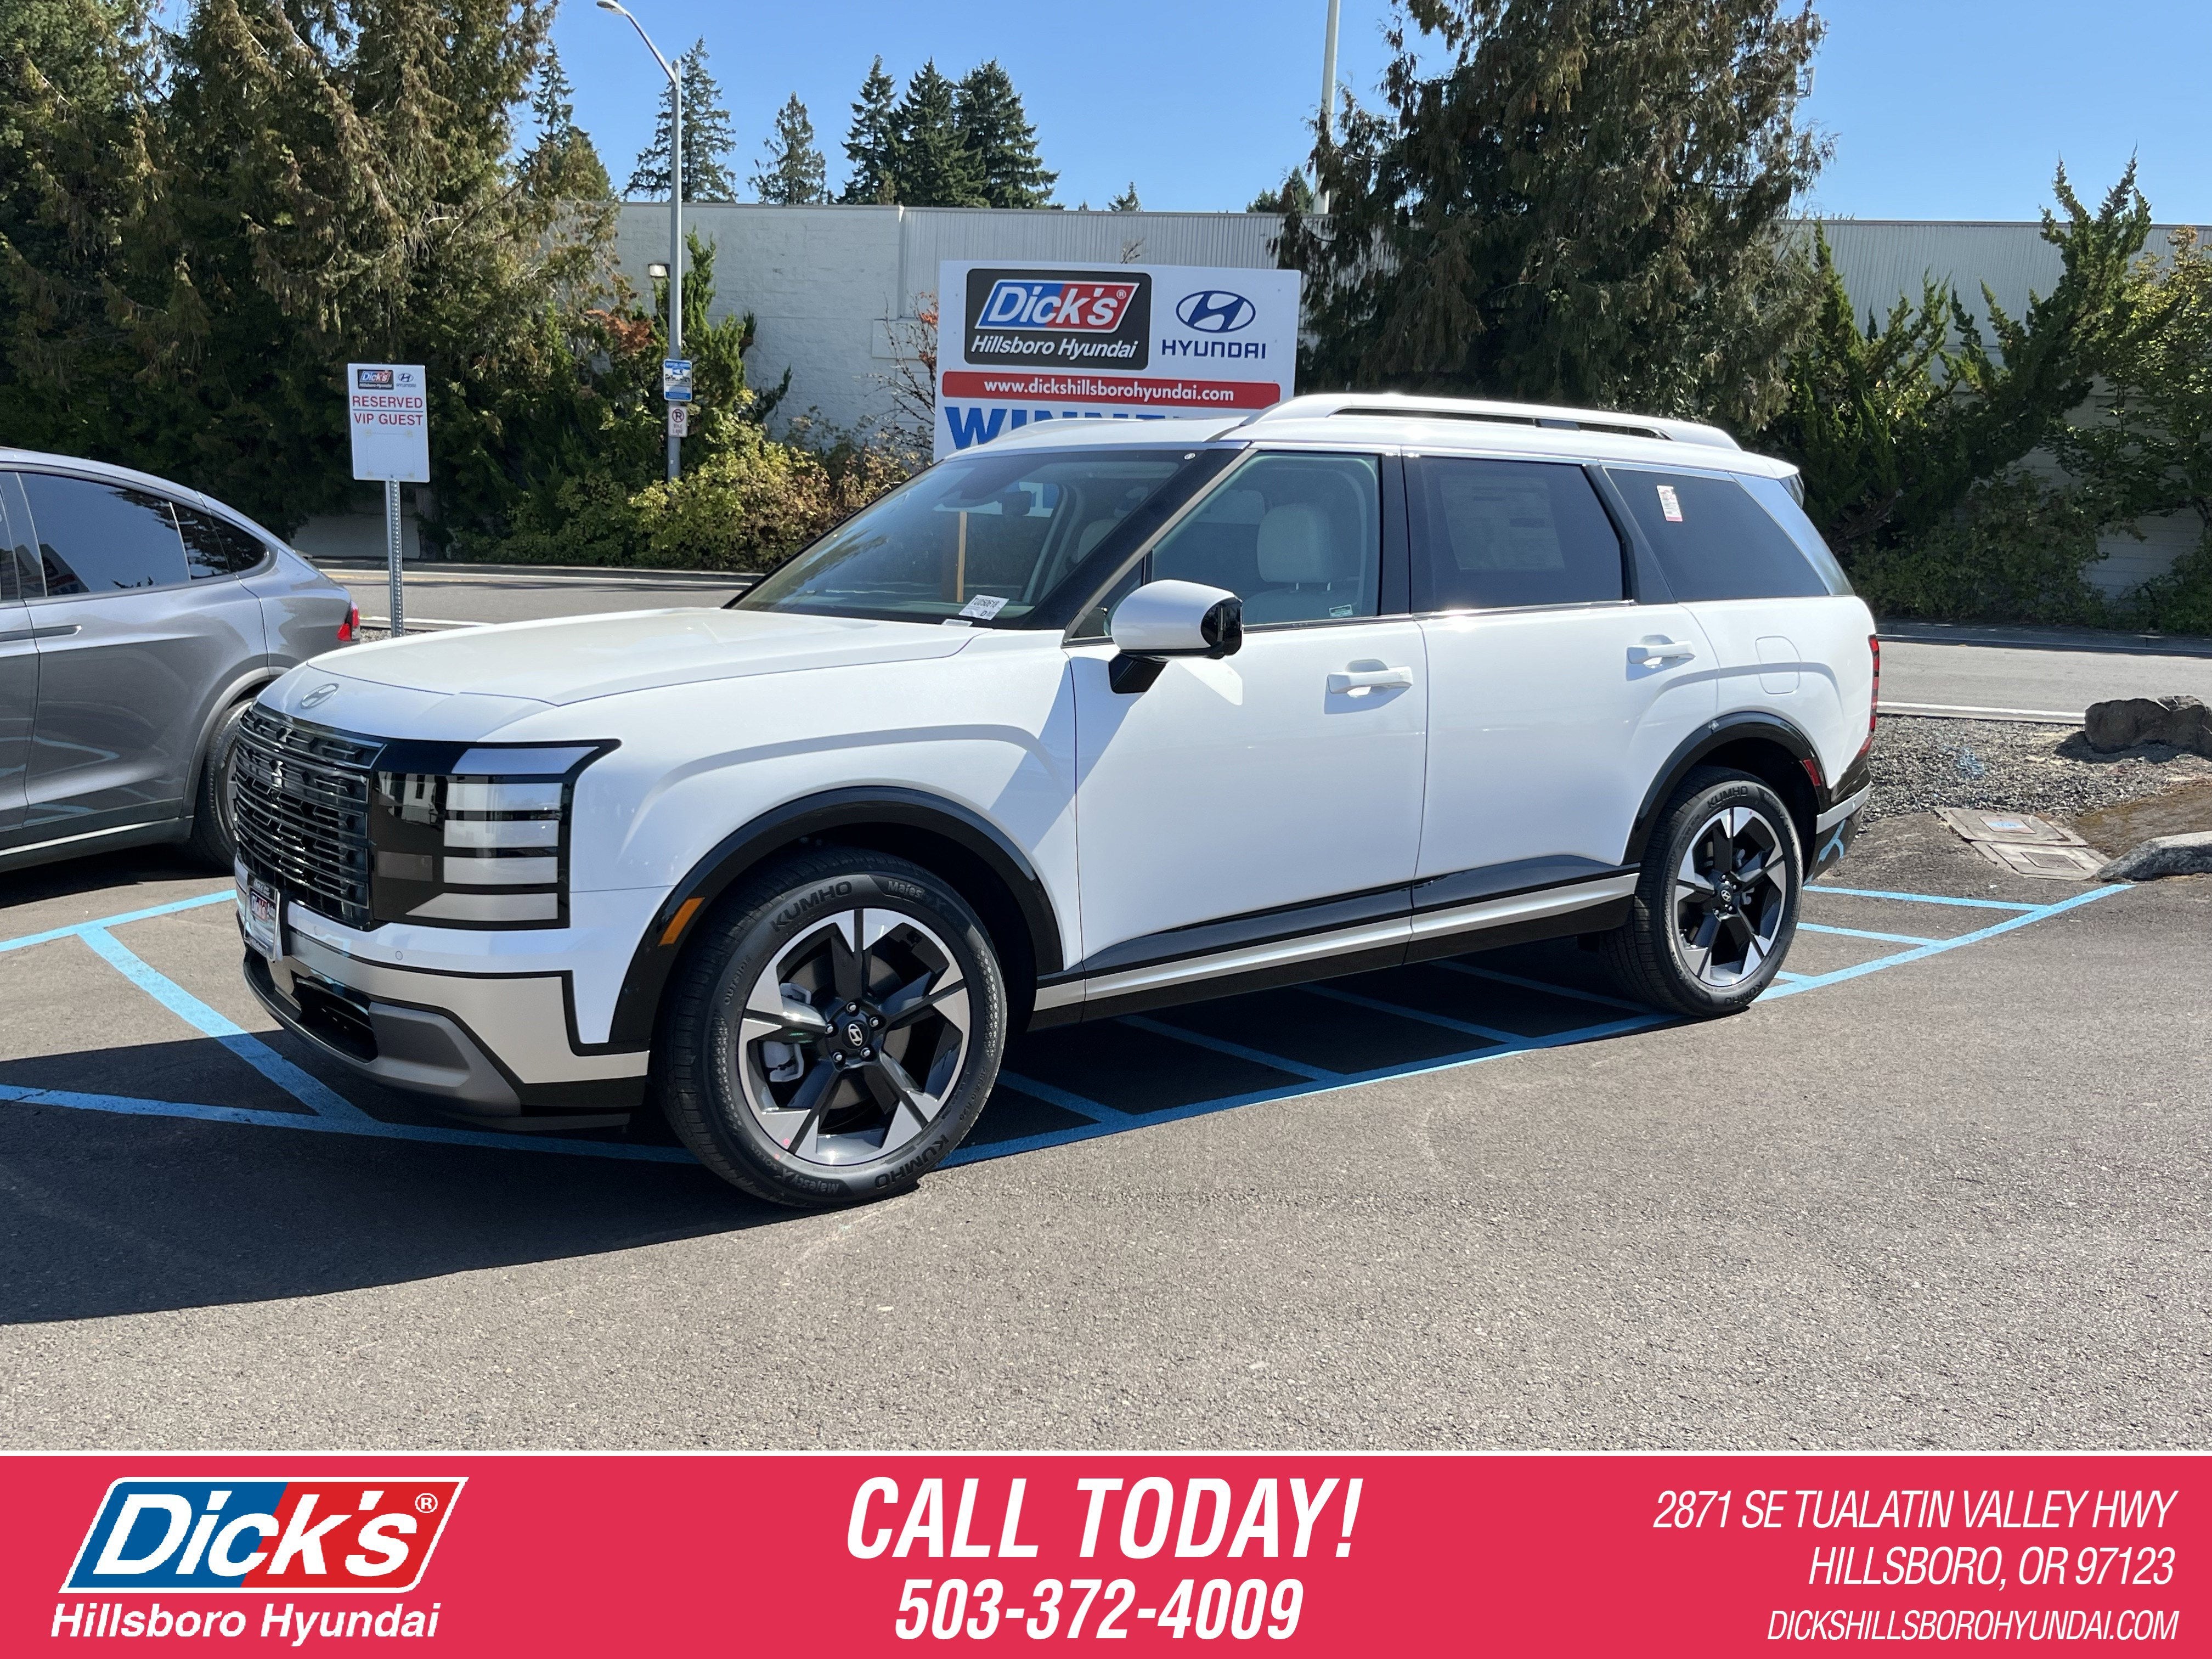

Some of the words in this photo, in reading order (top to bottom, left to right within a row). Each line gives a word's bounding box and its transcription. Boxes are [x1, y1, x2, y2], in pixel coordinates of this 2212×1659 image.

[988, 286, 1118, 326] Dick's
[970, 335, 1055, 356] Hillsboro
[1058, 338, 1138, 360] Hyundai
[1161, 338, 1267, 359] HYUNDAI
[984, 377, 1234, 402] www.dickshillsborohyundai.com
[352, 396, 423, 409] RESERVED
[354, 413, 374, 424] VIP
[379, 414, 424, 426] GUEST
[1707, 786, 1748, 809] KUMHO
[770, 881, 853, 932] KUMHO
[1724, 981, 1763, 1006] KUMHO
[874, 1134, 949, 1188] KUMHO
